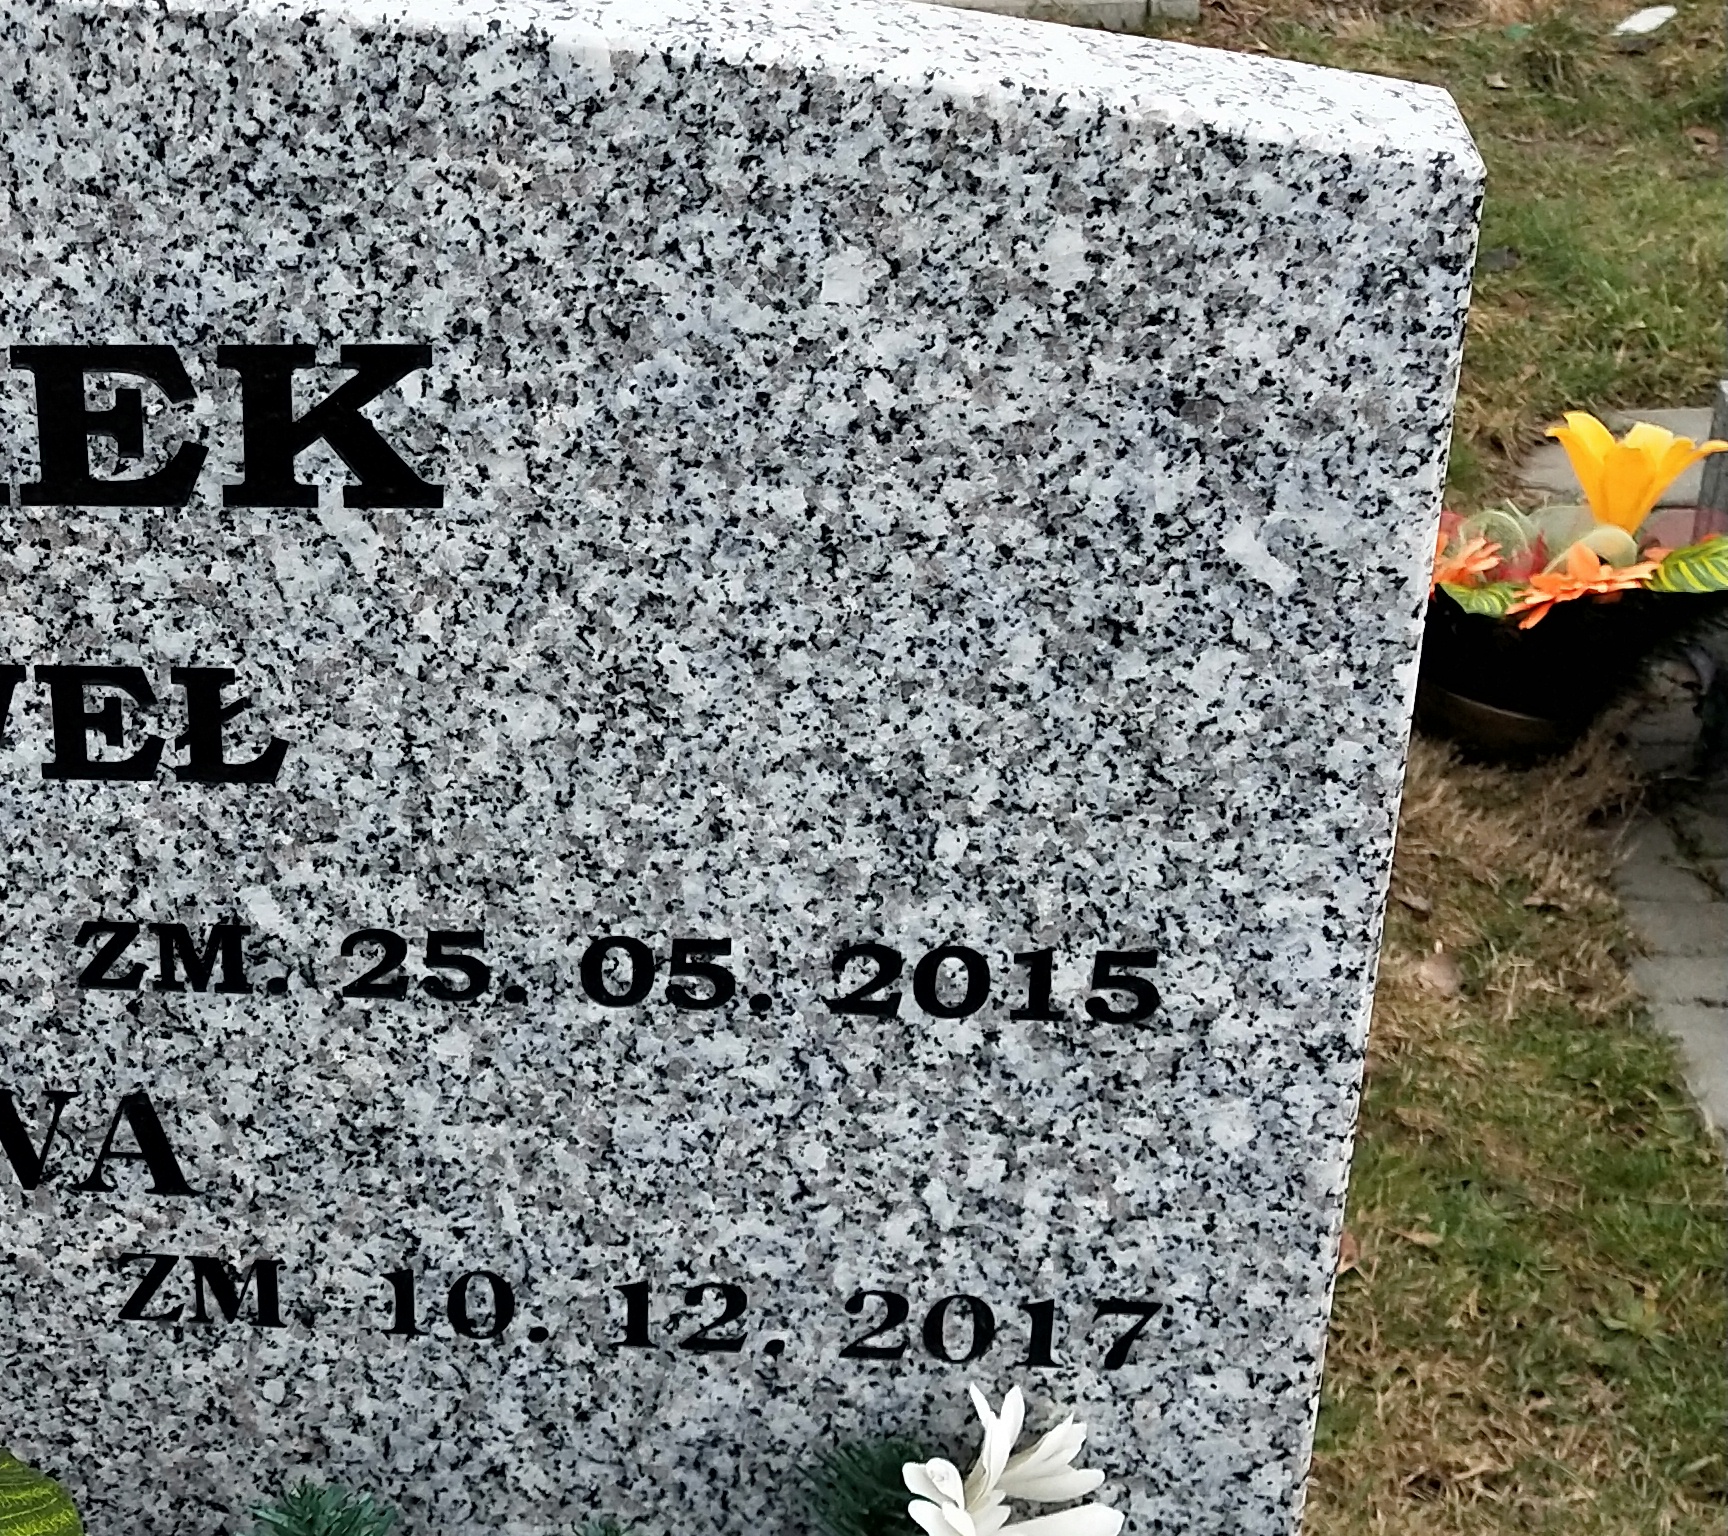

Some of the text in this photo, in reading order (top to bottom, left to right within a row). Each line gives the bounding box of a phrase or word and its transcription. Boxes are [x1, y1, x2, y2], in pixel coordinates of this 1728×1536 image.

[73, 920, 289, 995] ZM.
[339, 928, 528, 1004] 25.
[579, 935, 773, 1013] 05.
[828, 943, 1161, 1024] 2015
[379, 1268, 550, 1344] 10.
[613, 1280, 786, 1357] 12.
[839, 1290, 1164, 1370] 2017
